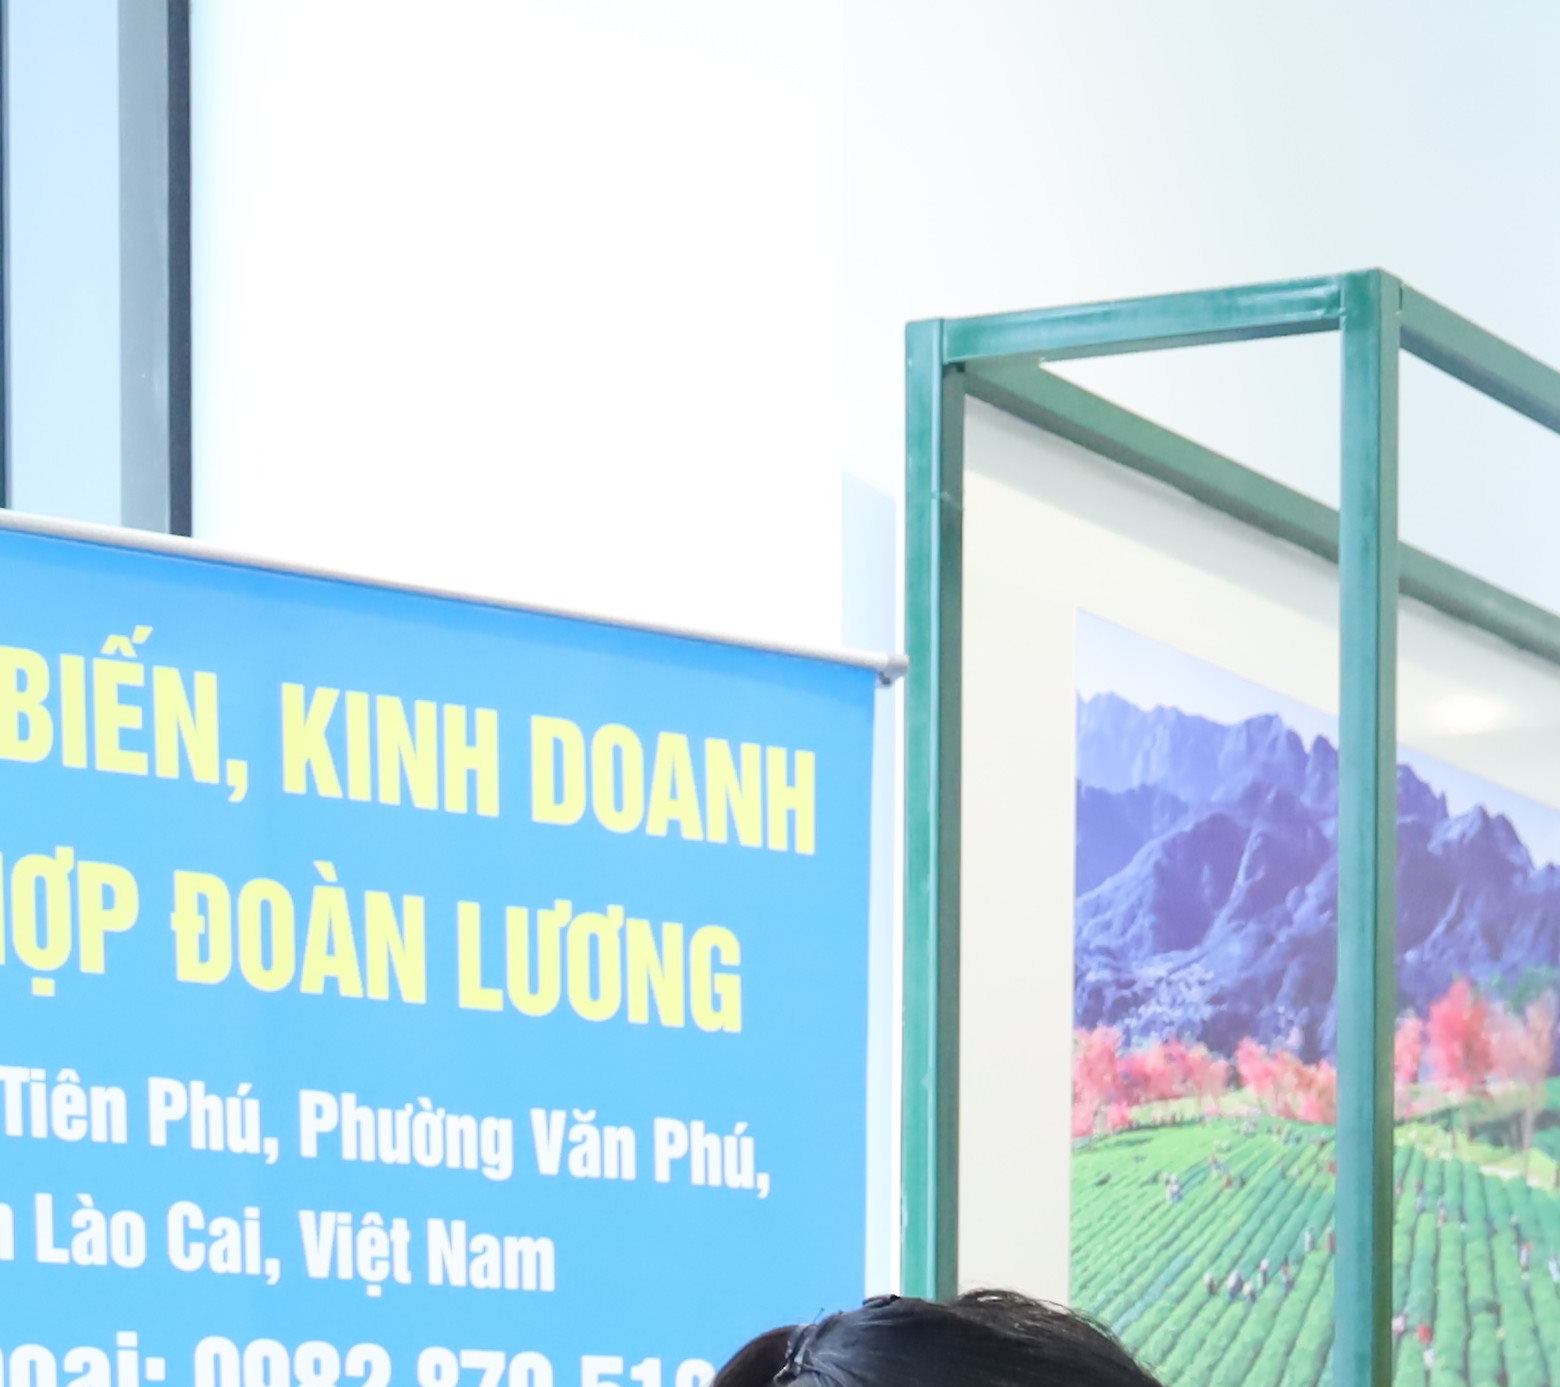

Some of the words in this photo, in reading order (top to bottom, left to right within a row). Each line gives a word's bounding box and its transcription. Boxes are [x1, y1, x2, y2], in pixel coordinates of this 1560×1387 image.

[281, 682, 499, 815] KINH
[531, 721, 816, 857] DOANH
[171, 863, 427, 1004] ĐOÀN
[457, 899, 743, 1033] LƯƠNG
[148, 1081, 280, 1163] Phú,
[299, 1088, 514, 1180] Phường
[530, 1107, 636, 1180] Văn
[653, 1117, 770, 1198] Phú,
[34, 1191, 146, 1268] Lào
[166, 1204, 280, 1284] Cai,
[299, 1209, 411, 1296] Việt
[428, 1220, 556, 1292] Nam
